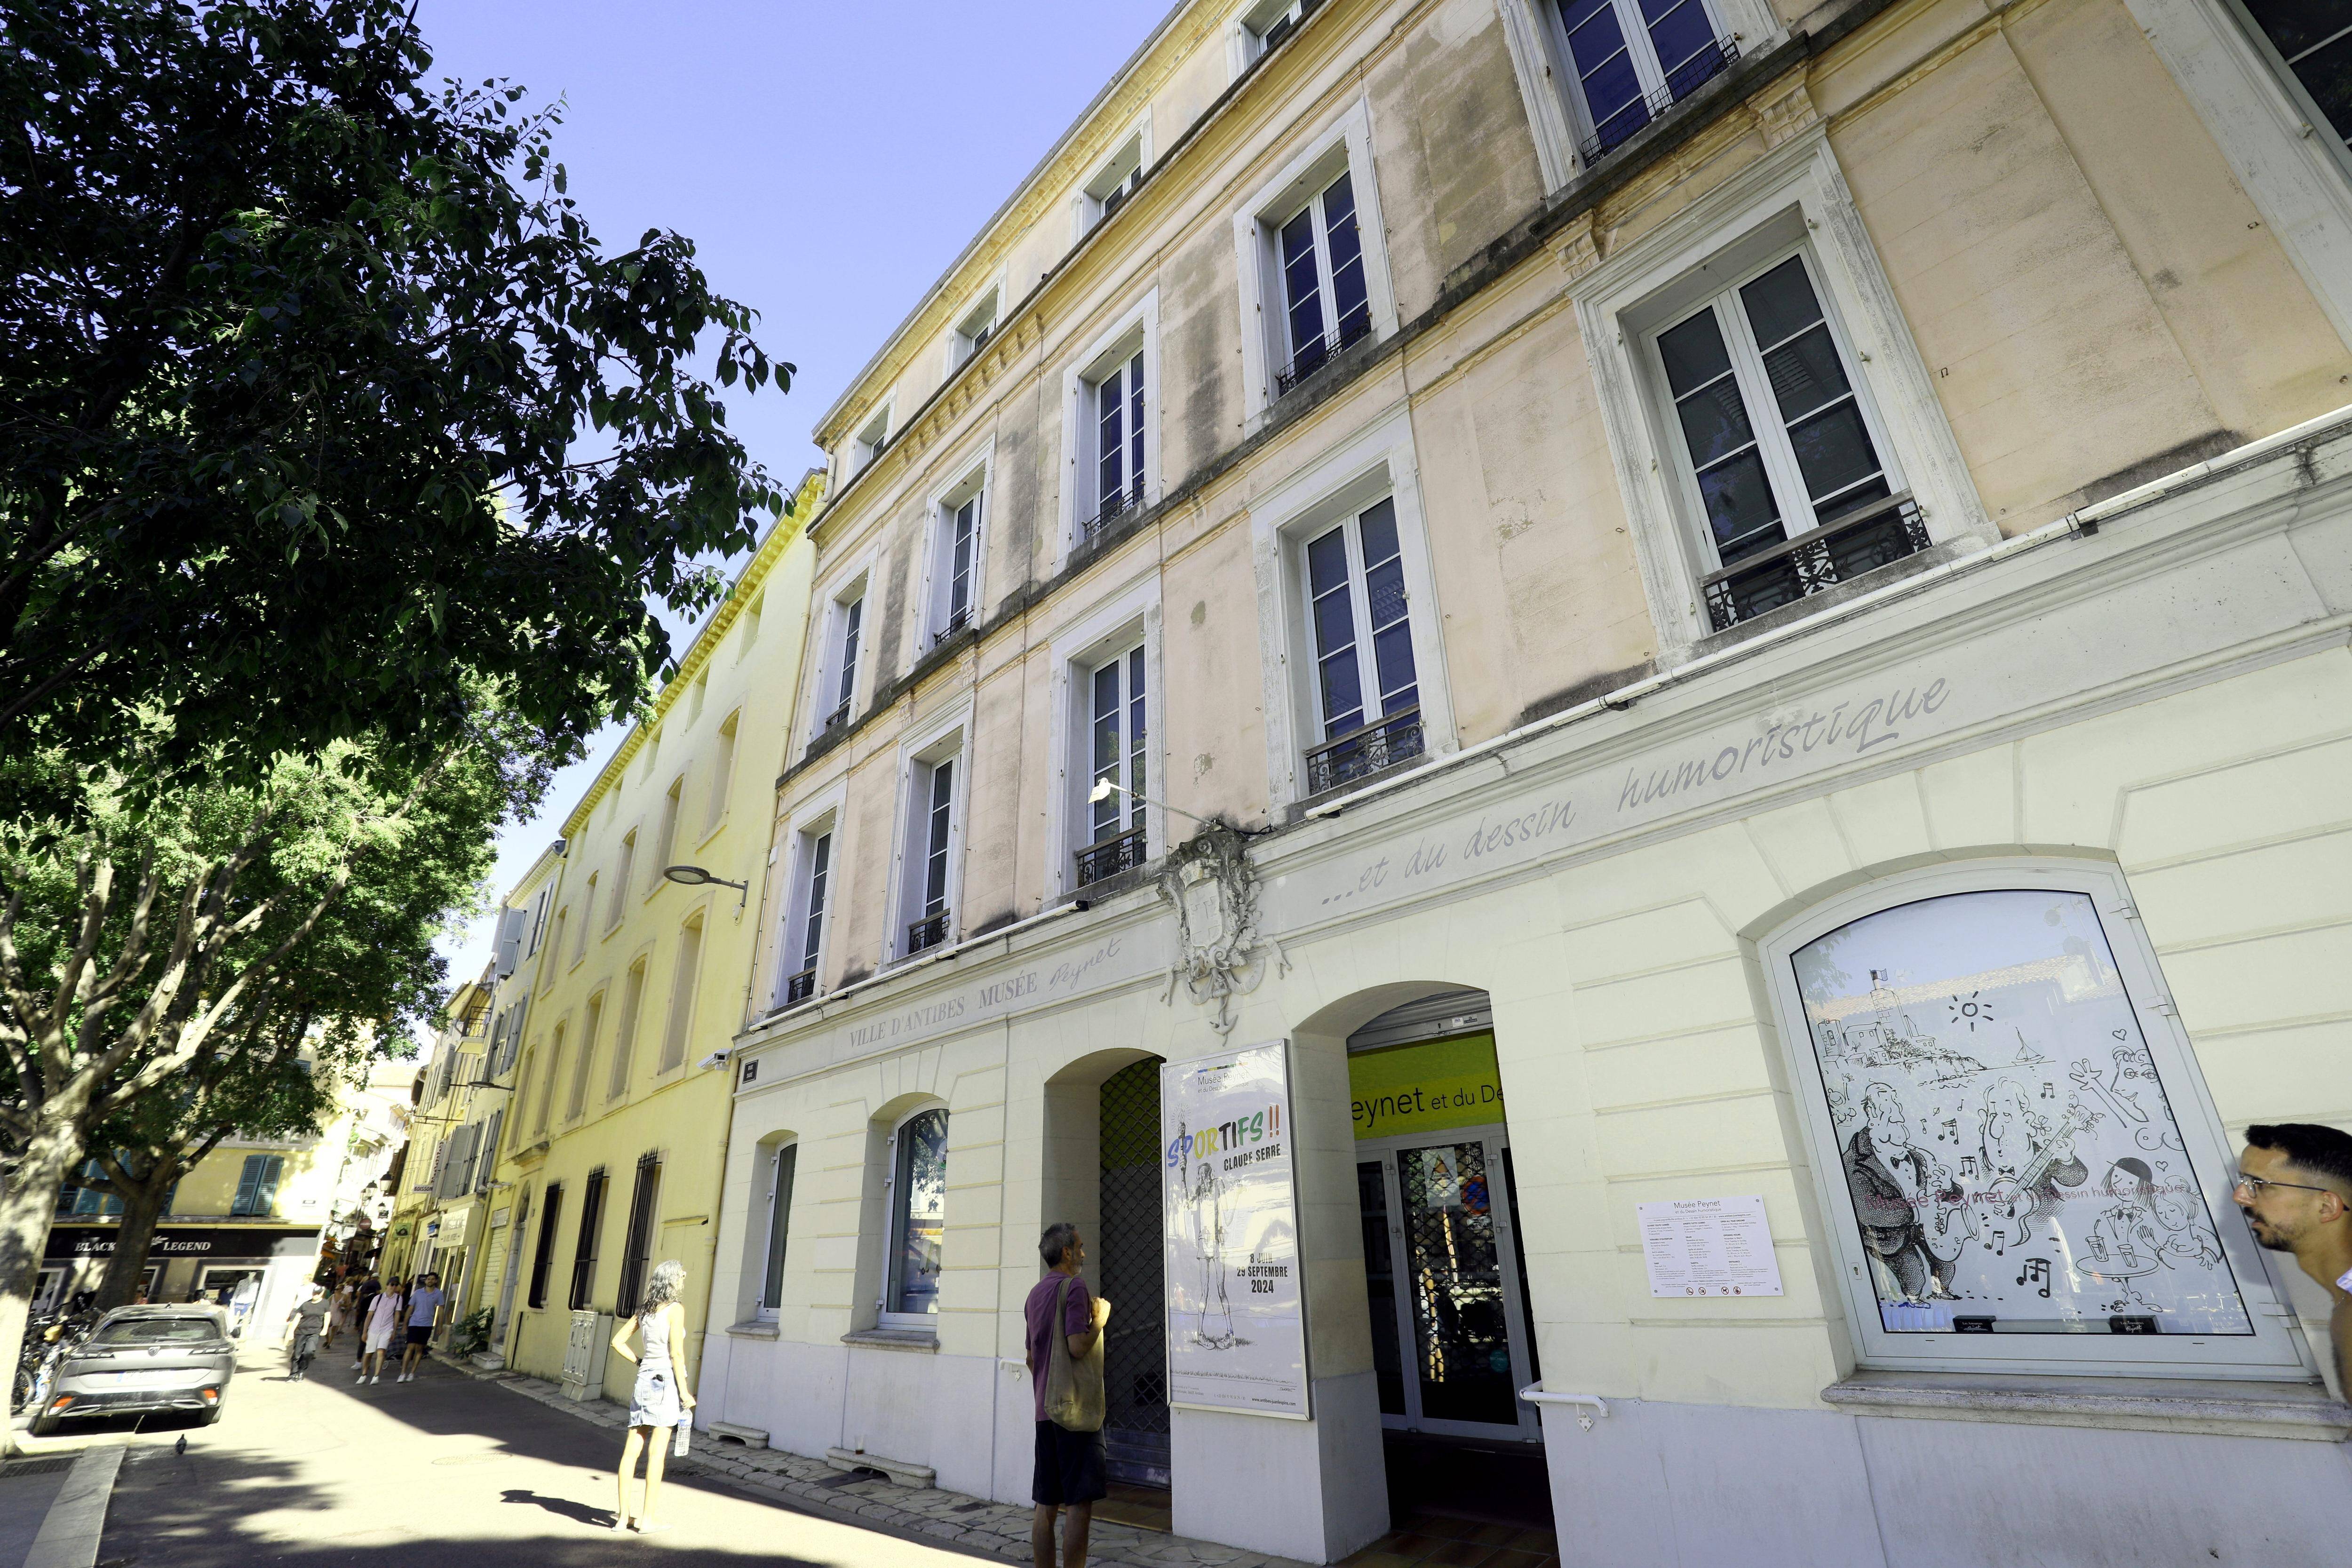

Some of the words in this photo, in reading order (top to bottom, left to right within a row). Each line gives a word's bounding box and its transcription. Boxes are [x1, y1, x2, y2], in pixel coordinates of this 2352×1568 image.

[1405, 837, 1447, 878] du
[1464, 800, 1576, 860] dessin
[1617, 677, 1951, 812] humoristique
[850, 1022, 885, 1048] VILLE
[891, 996, 965, 1035] D'ANTIBES
[978, 970, 1038, 1008] MUSÉE
[1049, 937, 1122, 991] Peynet
[1198, 1074, 1221, 1085] Musée
[1351, 1088, 1424, 1128] eynet
[1431, 1094, 1448, 1109] et
[1454, 1088, 1475, 1106] du
[1168, 1111, 1263, 1168] SPORTIFS
[1224, 1152, 1253, 1171] CLAUDE
[1256, 1144, 1281, 1162] SERRE
[1697, 1200, 1721, 1209] Peynet
[1935, 1189, 2005, 1209] Peynet
[74, 1242, 116, 1251] BLACK
[163, 1242, 211, 1251] LEGEND
[1250, 1253, 1254, 1263] 8
[1257, 1253, 1272, 1264] JUIN
[1237, 1266, 1246, 1276] 29
[1248, 1266, 1288, 1277] SEPTEMBRE
[1251, 1280, 1274, 1293] 2024
